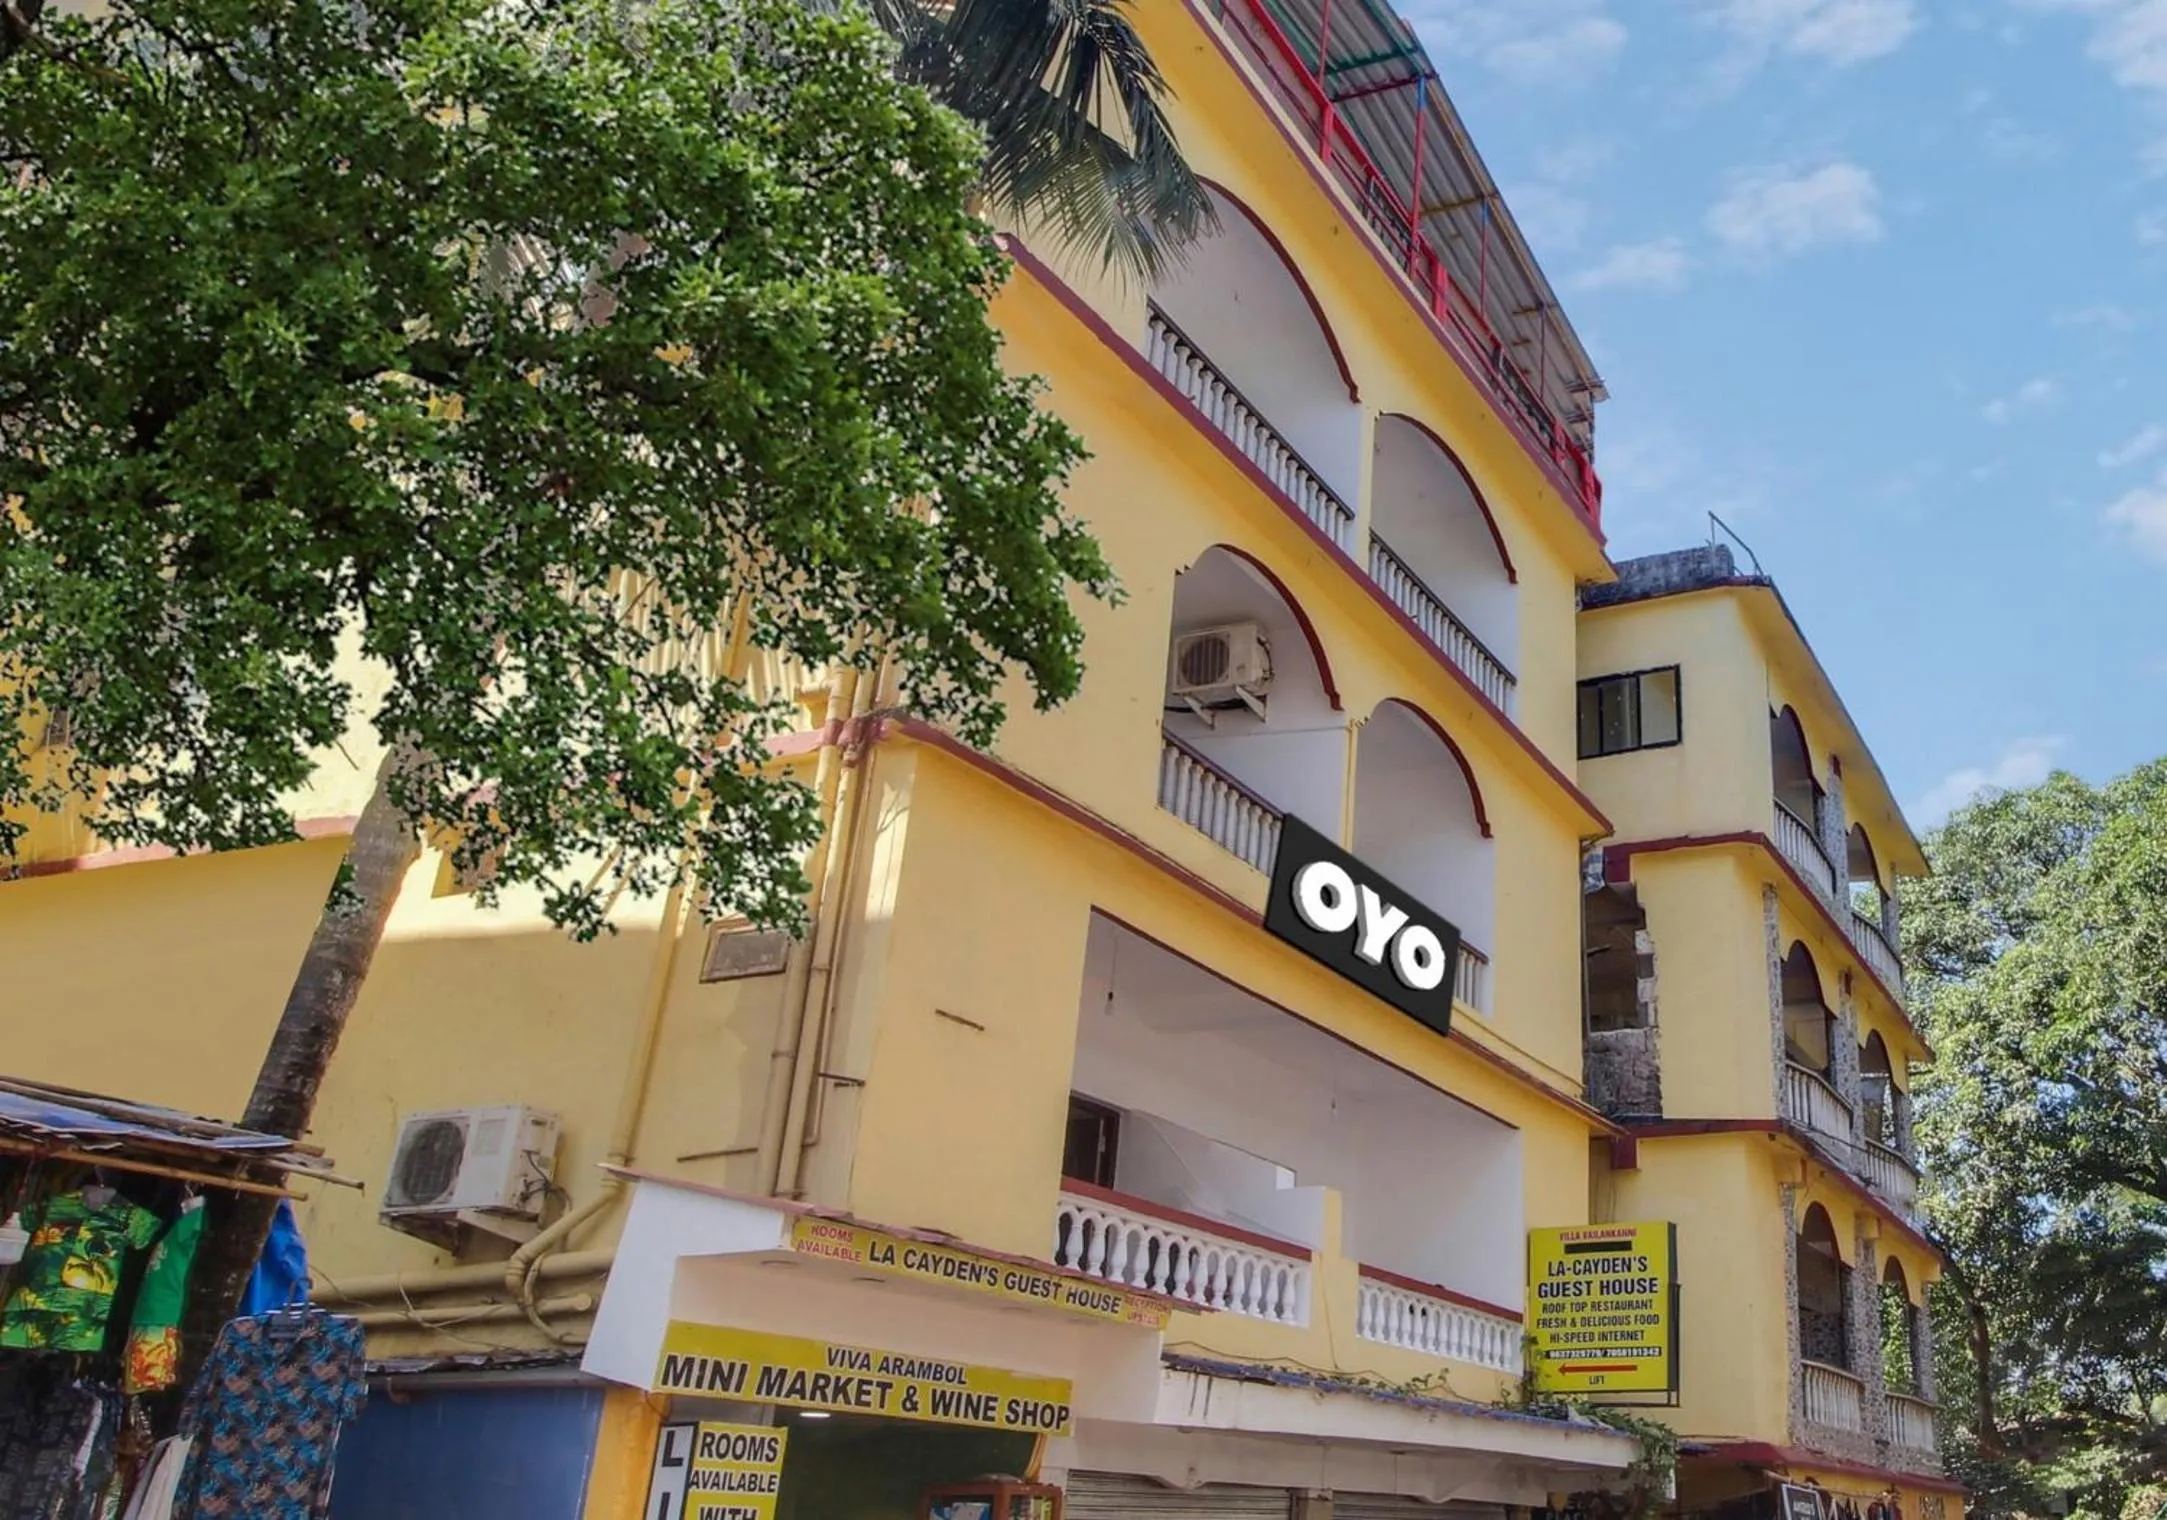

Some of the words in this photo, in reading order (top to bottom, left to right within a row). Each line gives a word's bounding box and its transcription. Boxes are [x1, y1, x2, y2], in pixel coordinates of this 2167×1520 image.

[1292, 860, 1446, 990] OYO
[811, 1224, 854, 1243] ROOMS
[797, 1239, 862, 1263] AVAILABLE
[869, 1240, 895, 1265] LA
[903, 1248, 999, 1287] CAYDEN'S
[1004, 1271, 1062, 1300] GUEST
[1065, 1287, 1122, 1314] HOUSE
[1548, 1256, 1648, 1277] LA-CAYDEN'S
[1538, 1281, 1593, 1299] GUEST
[1600, 1278, 1659, 1296] HOUSE
[1542, 1303, 1566, 1314] ROOF
[1570, 1302, 1587, 1313] TOP
[1590, 1299, 1653, 1312] RESTAURANT
[1537, 1318, 1567, 1329] FRESH
[1570, 1317, 1577, 1327] &
[1580, 1315, 1631, 1328] DELICIOUS
[1634, 1314, 1660, 1326] FOOD
[1550, 1332, 1595, 1344] HI-SPEED
[1598, 1330, 1645, 1342] INTERNET
[827, 1347, 871, 1372] VIVA
[877, 1355, 967, 1385] ARAMBOL
[661, 1354, 748, 1394] MINI
[755, 1366, 893, 1410] MARKET
[901, 1385, 919, 1413] &
[931, 1388, 999, 1423] WINE
[1005, 1399, 1070, 1430] SHOP
[1589, 1376, 1605, 1386] LIFT
[700, 1431, 779, 1463] ROOMS
[690, 1469, 778, 1494] AVAILABLE
